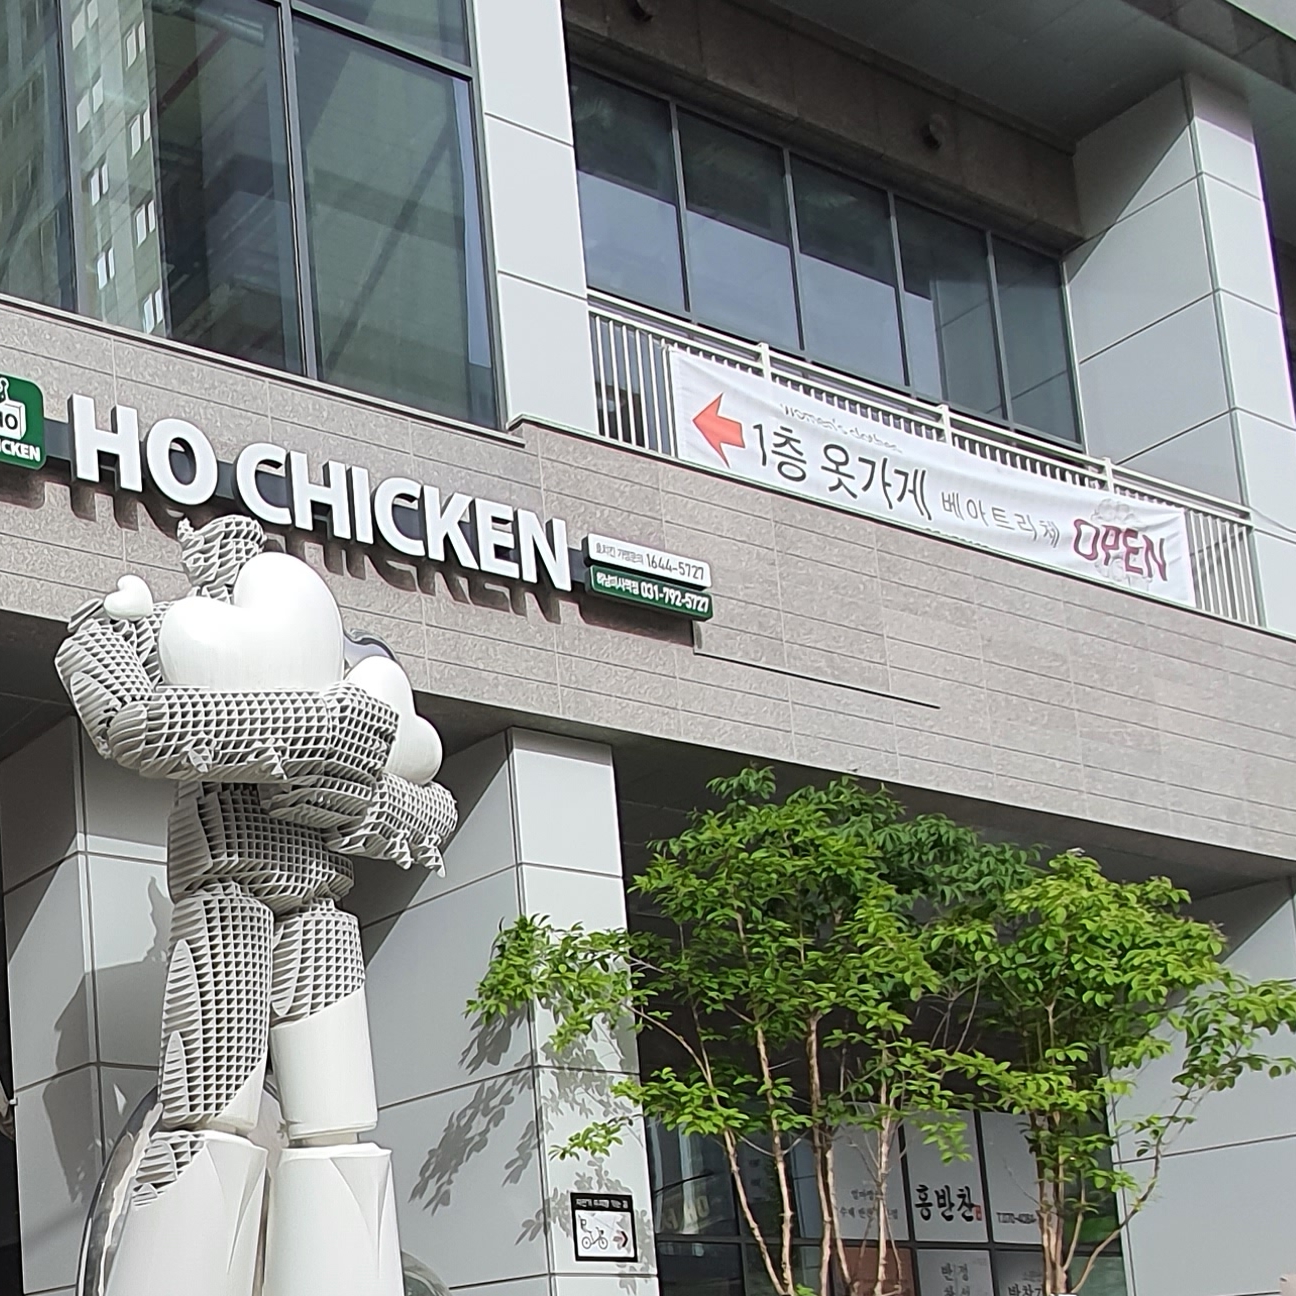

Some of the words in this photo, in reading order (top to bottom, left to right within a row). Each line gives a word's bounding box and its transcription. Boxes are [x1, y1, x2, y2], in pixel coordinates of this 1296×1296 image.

[71, 394, 219, 505] HO
[236, 441, 572, 591] CHICKEN
[753, 423, 807, 482] 1층
[821, 443, 932, 521] 옷가게
[1073, 519, 1168, 581] OPEN
[646, 553, 704, 580] 1644-5727
[641, 582, 709, 613] 031-792-5727
[915, 1184, 975, 1222] 홍반찬
